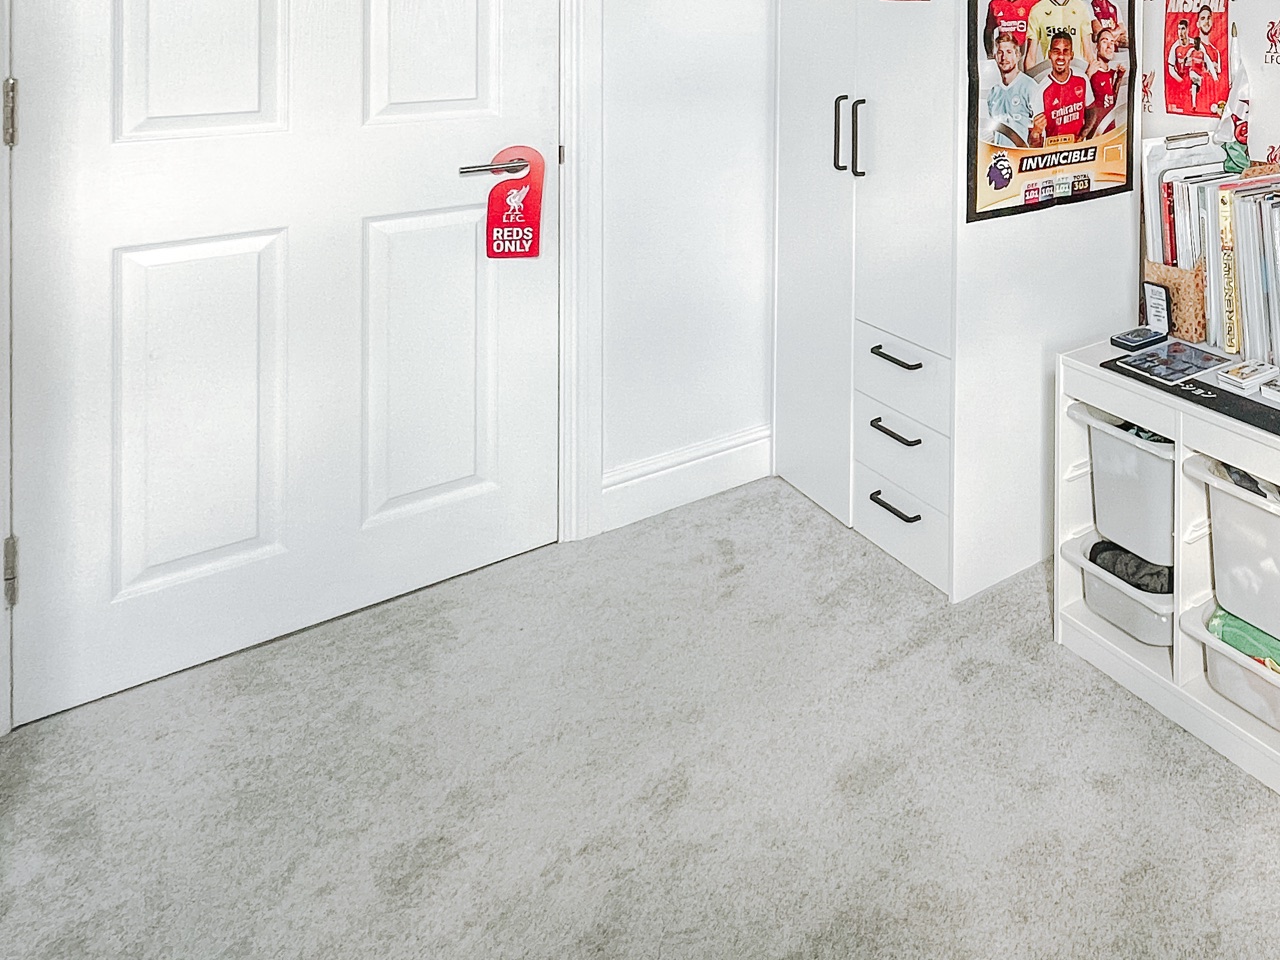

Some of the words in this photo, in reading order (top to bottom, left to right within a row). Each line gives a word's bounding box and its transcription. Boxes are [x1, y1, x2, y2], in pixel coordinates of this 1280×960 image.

[1051, 103, 1083, 120] Emirates
[1021, 147, 1096, 172] INVINCIBLE
[1025, 189, 1040, 200] 101
[1041, 185, 1054, 197] 101
[1055, 182, 1070, 193] 101
[1073, 179, 1089, 190] 303
[493, 227, 533, 241] REDS
[493, 240, 533, 253] ONLY
[1222, 250, 1236, 348] ADRENALYN
